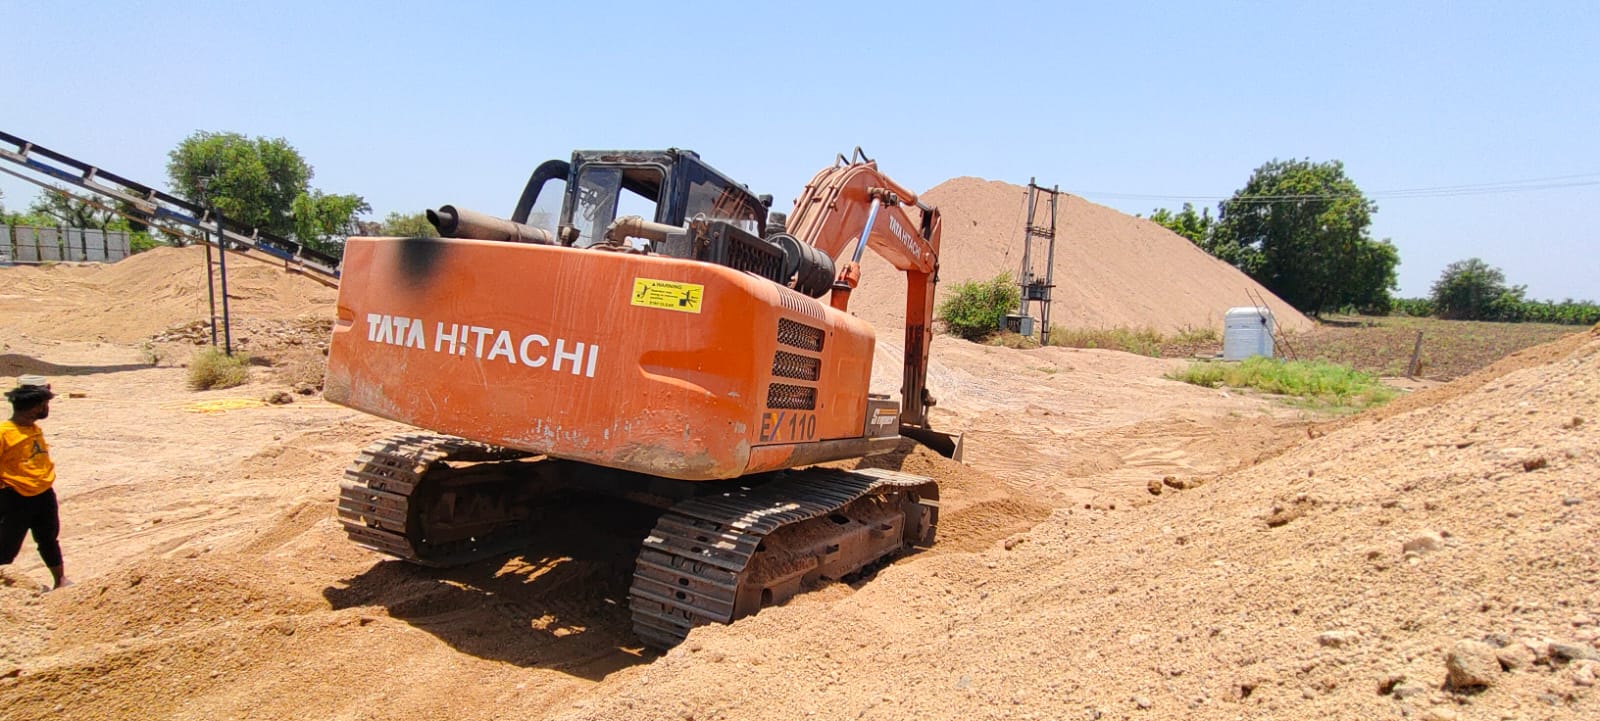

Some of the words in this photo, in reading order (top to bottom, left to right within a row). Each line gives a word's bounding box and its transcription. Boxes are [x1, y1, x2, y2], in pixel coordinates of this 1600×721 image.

[889, 214, 902, 241] TATA
[901, 229, 921, 260] HITACHI
[367, 313, 426, 350] TATA
[434, 321, 599, 378] HITACHI
[759, 411, 785, 442] EX
[789, 413, 816, 441] 110
